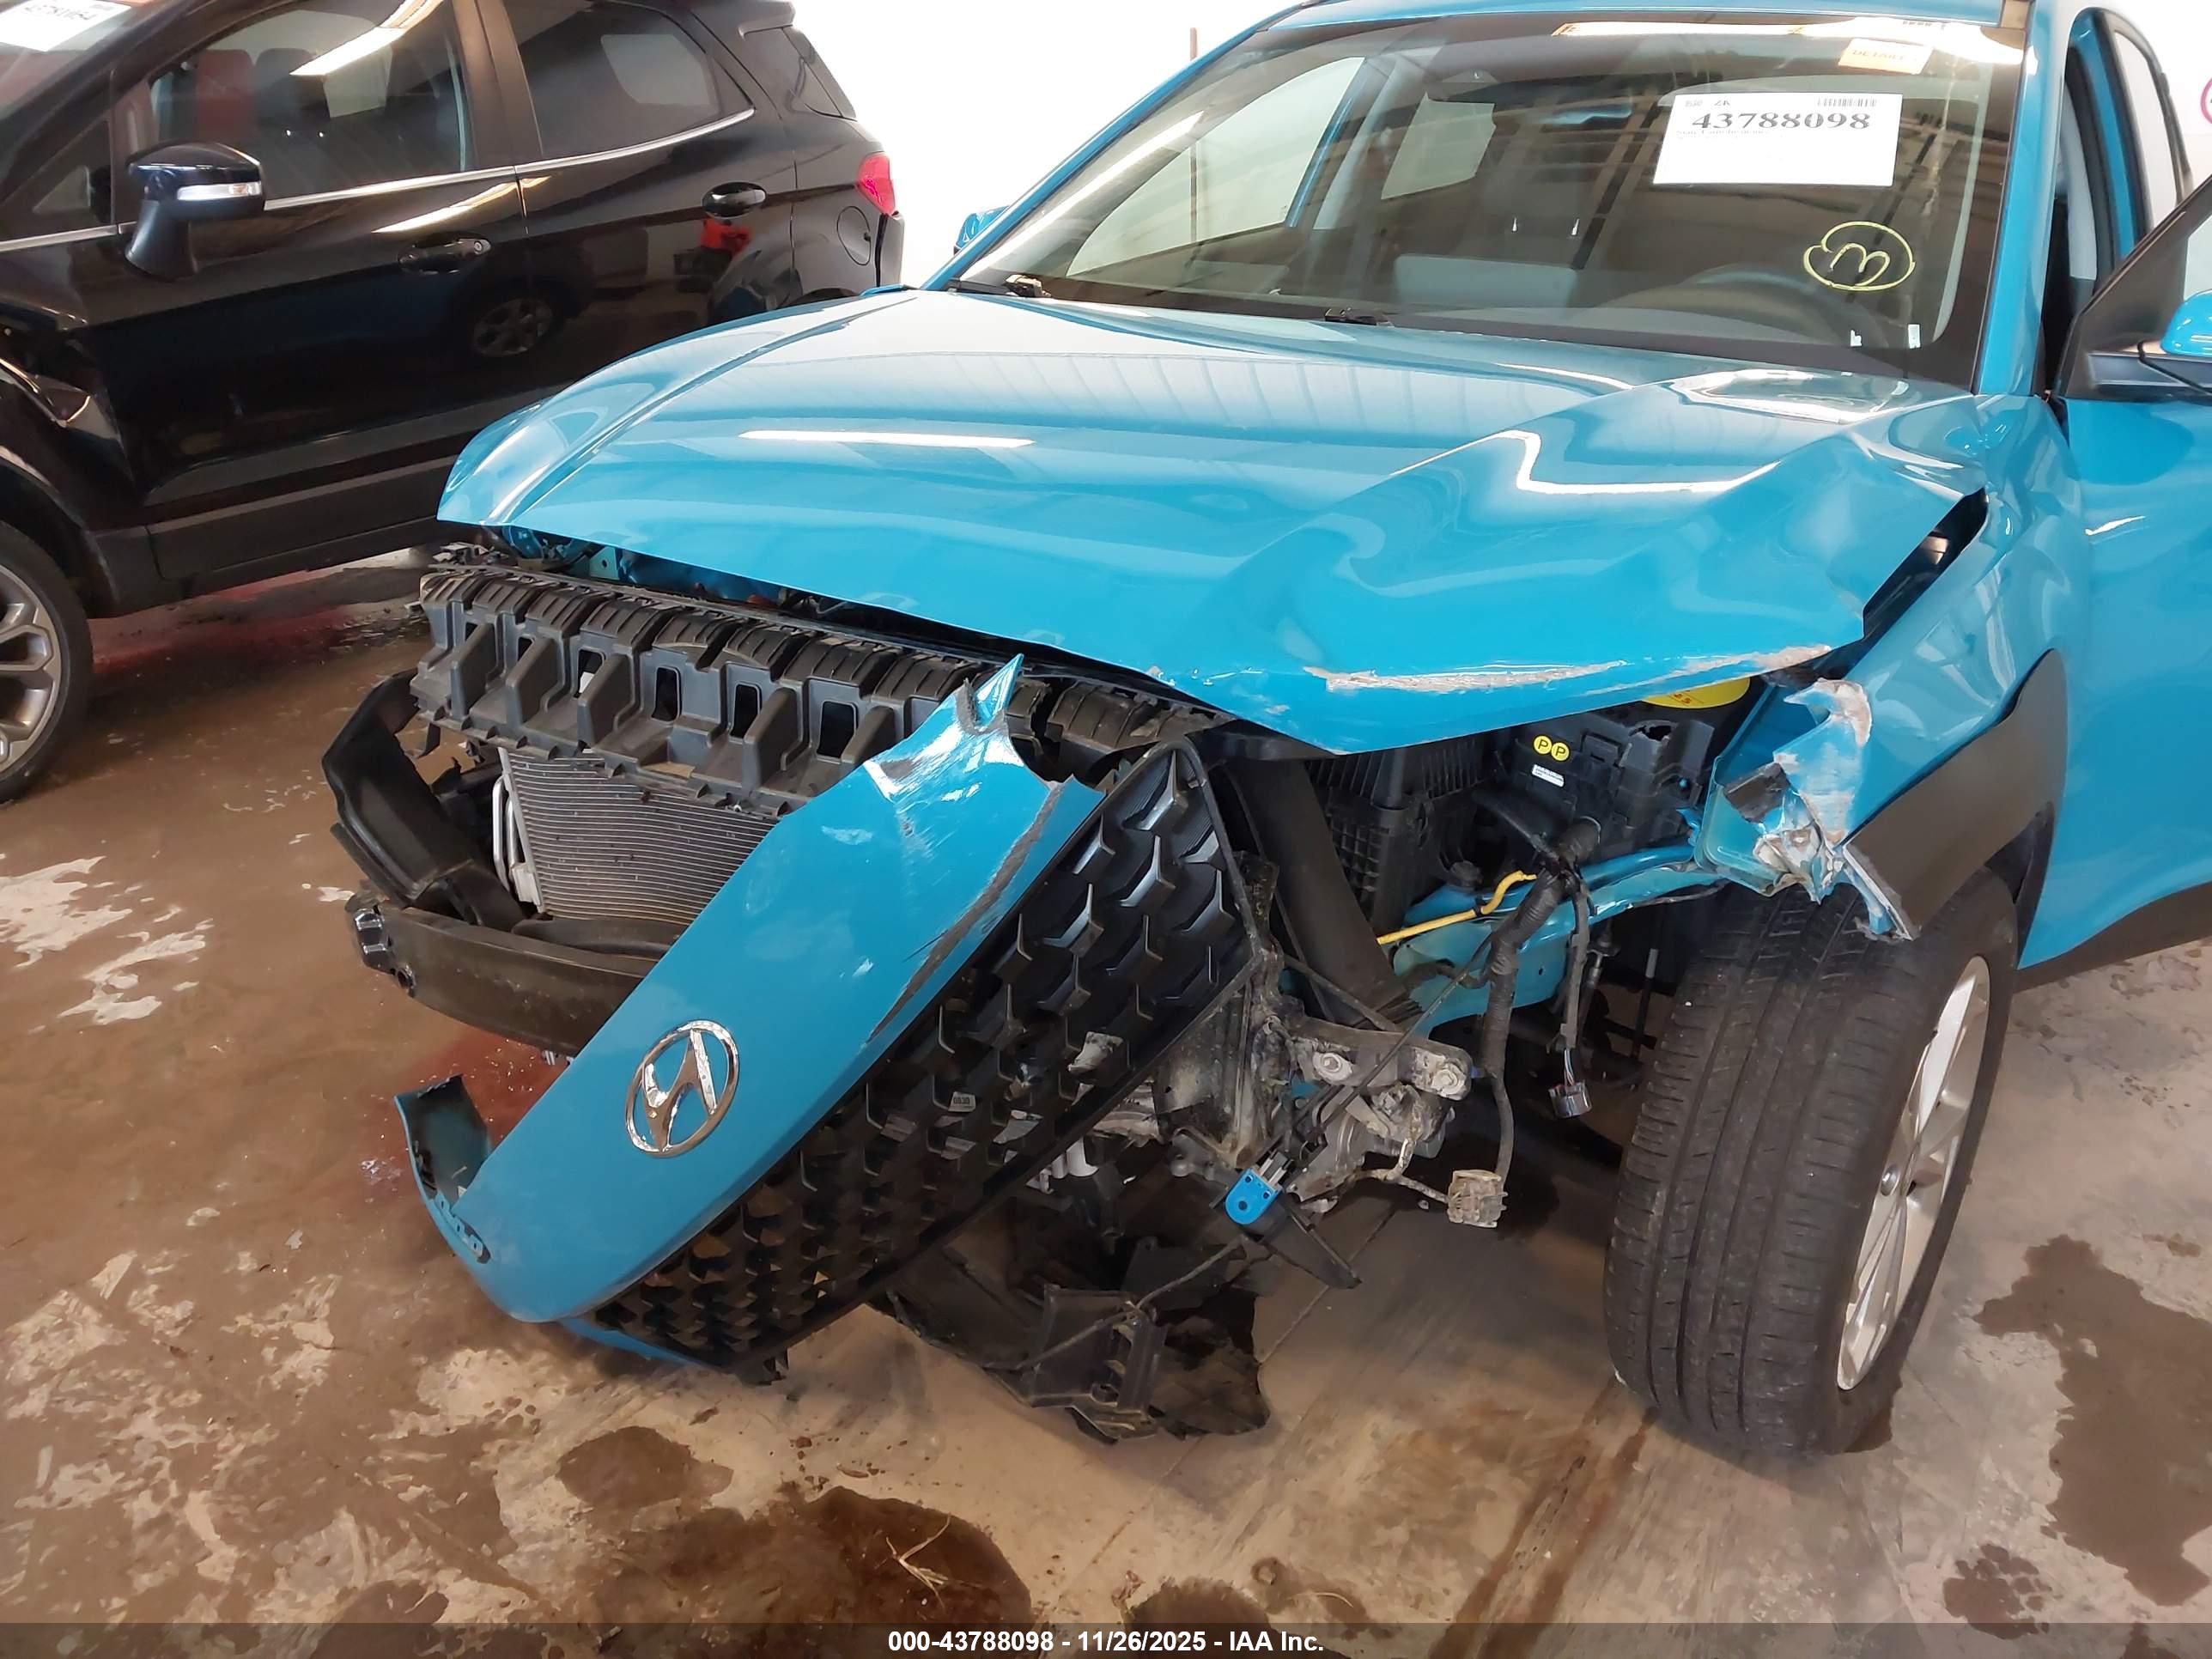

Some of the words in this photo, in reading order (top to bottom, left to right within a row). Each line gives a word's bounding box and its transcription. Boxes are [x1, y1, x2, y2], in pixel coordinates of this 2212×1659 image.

[1692, 112, 1871, 129] 43788098
[1538, 738, 1549, 750] P
[1555, 745, 1566, 757] P
